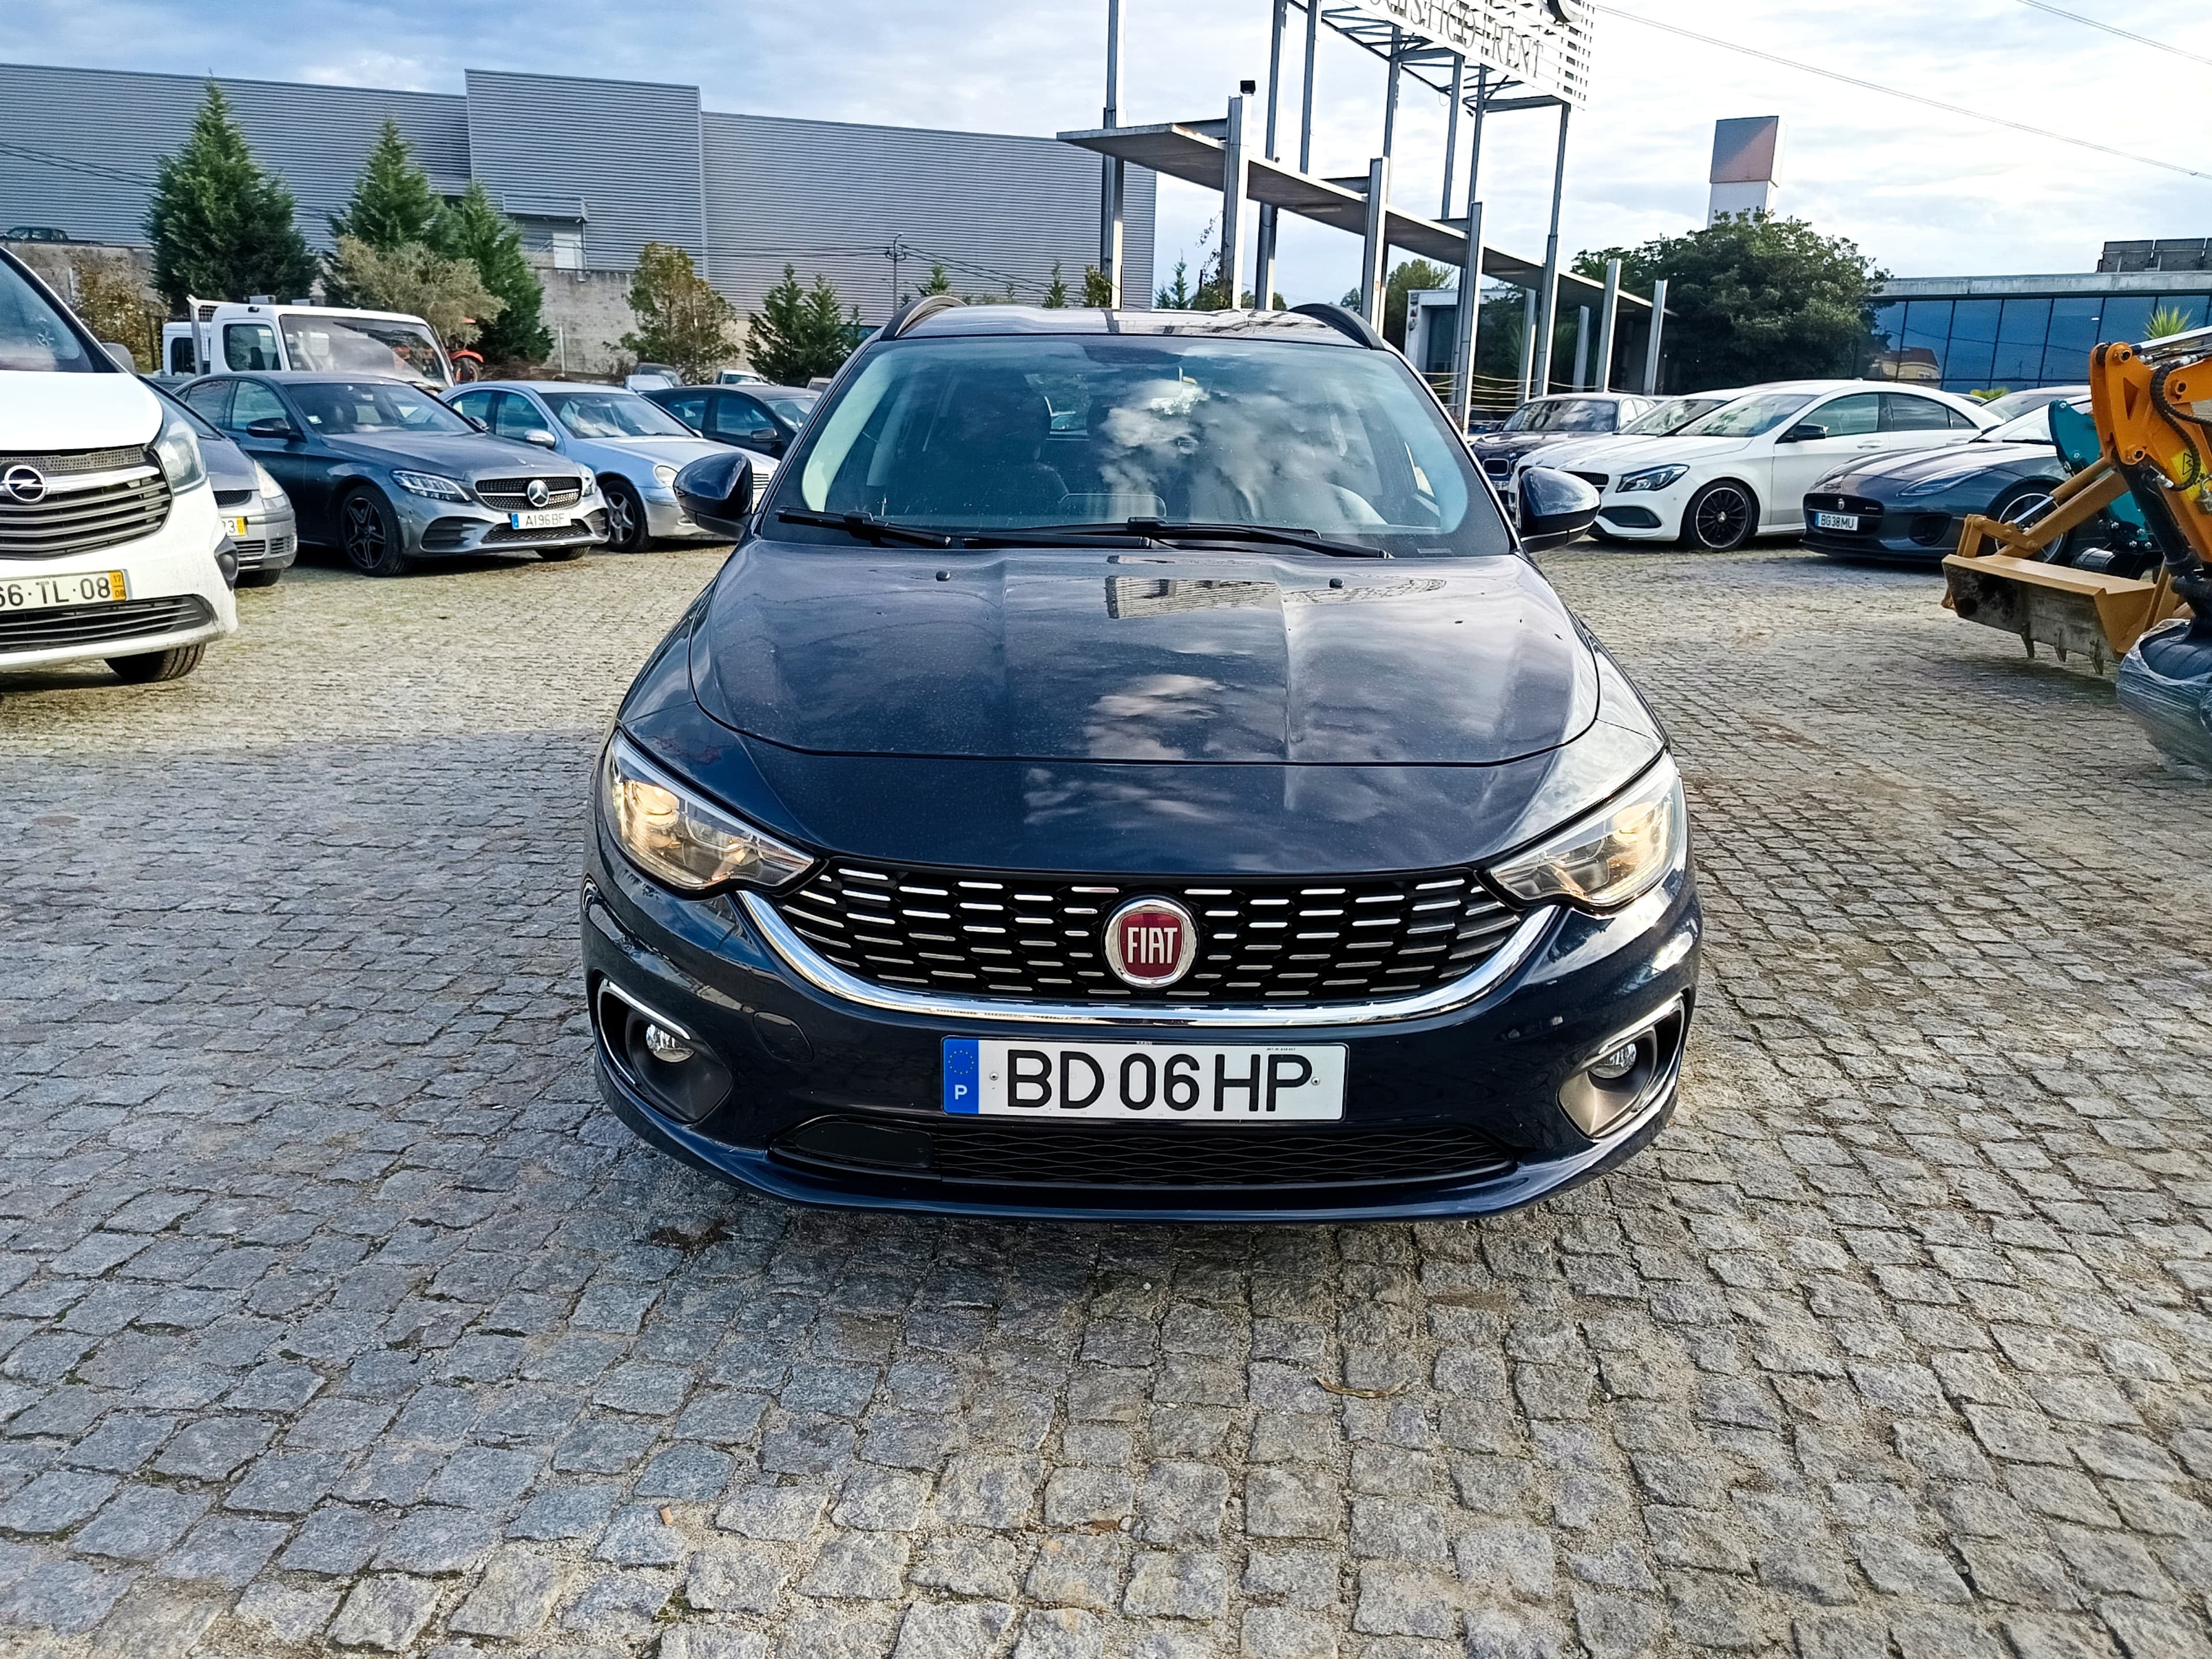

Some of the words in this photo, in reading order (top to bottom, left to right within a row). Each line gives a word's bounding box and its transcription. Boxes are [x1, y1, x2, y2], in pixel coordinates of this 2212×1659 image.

[1821, 515, 1854, 528] BG38MU
[1127, 926, 1178, 964] FIAT
[955, 1084, 968, 1100] P
